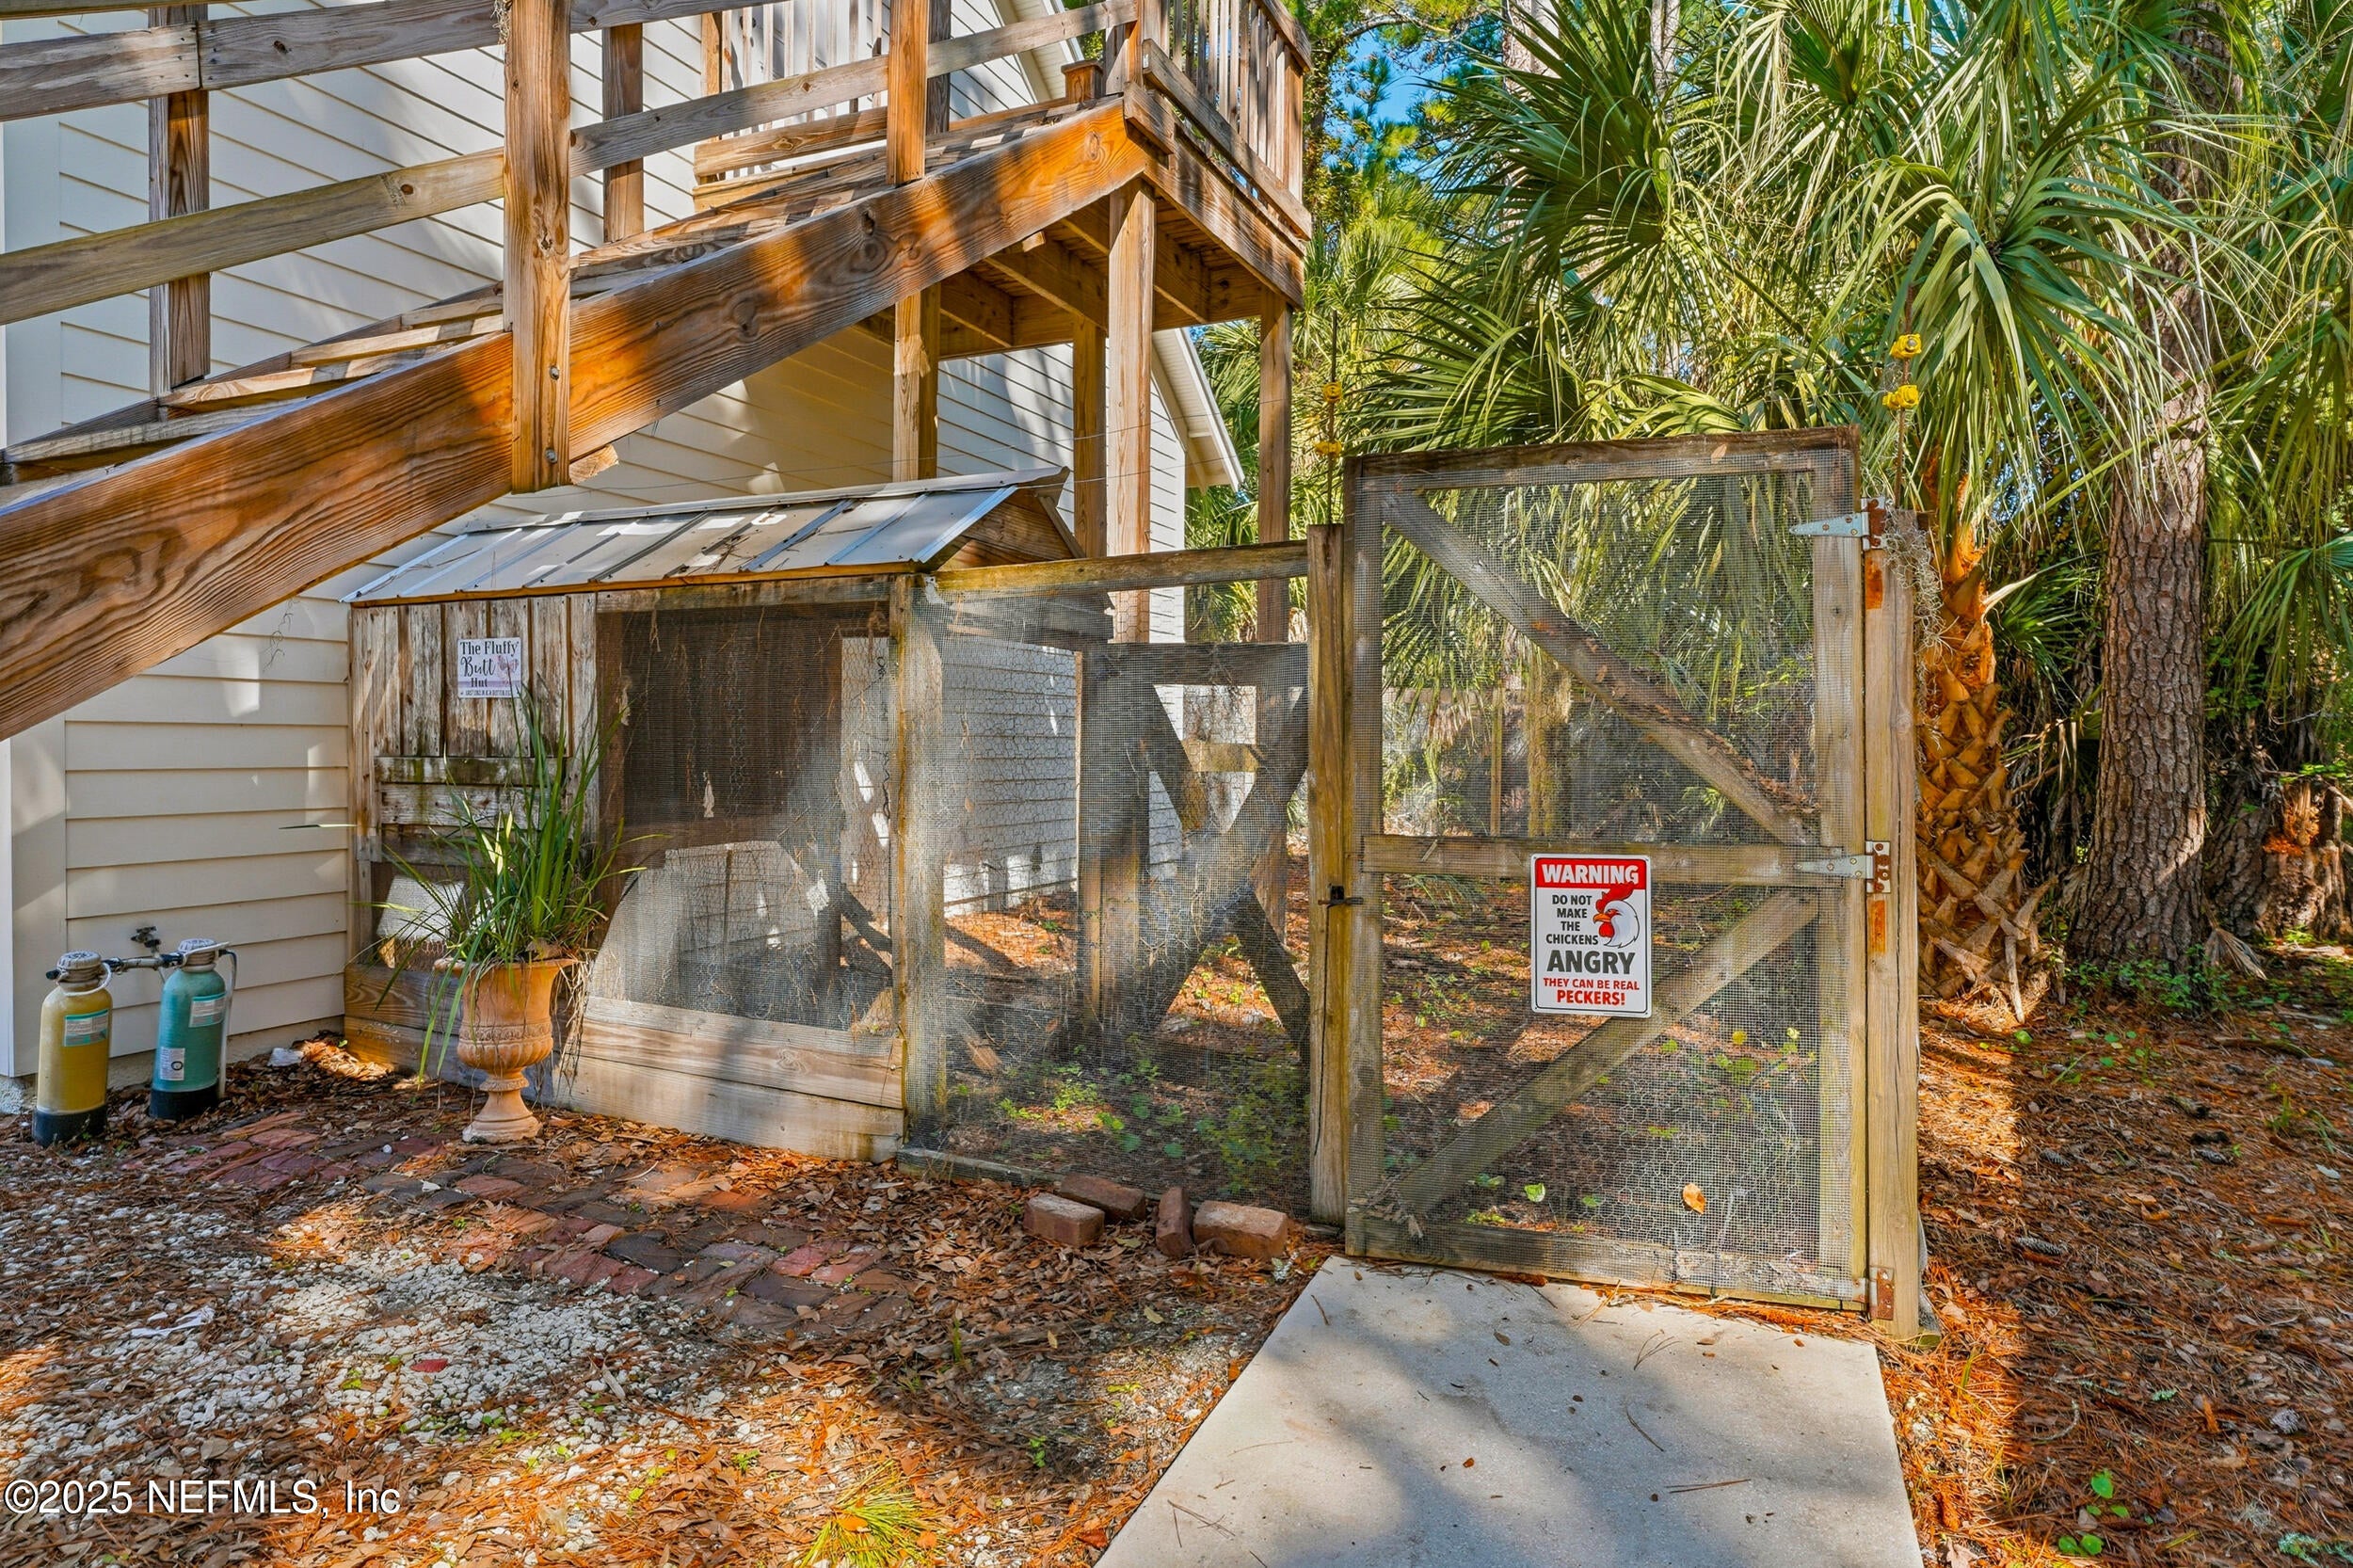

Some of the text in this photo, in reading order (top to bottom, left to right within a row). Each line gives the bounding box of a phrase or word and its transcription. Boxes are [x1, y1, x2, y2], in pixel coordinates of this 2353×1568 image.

[460, 640, 520, 657] The Fluffy
[460, 656, 496, 677] Butt
[471, 678, 488, 687] Hut
[1542, 864, 1639, 885] WARNING
[1552, 894, 1593, 905] DO NOT
[1557, 907, 1587, 919] MAKE
[1561, 920, 1580, 932] THE
[1545, 934, 1599, 945] CHICKENS
[1546, 950, 1636, 975] ANGRY
[1544, 978, 1640, 990] THEY CAN BE REAL
[1557, 990, 1625, 1005] PECKERS!
